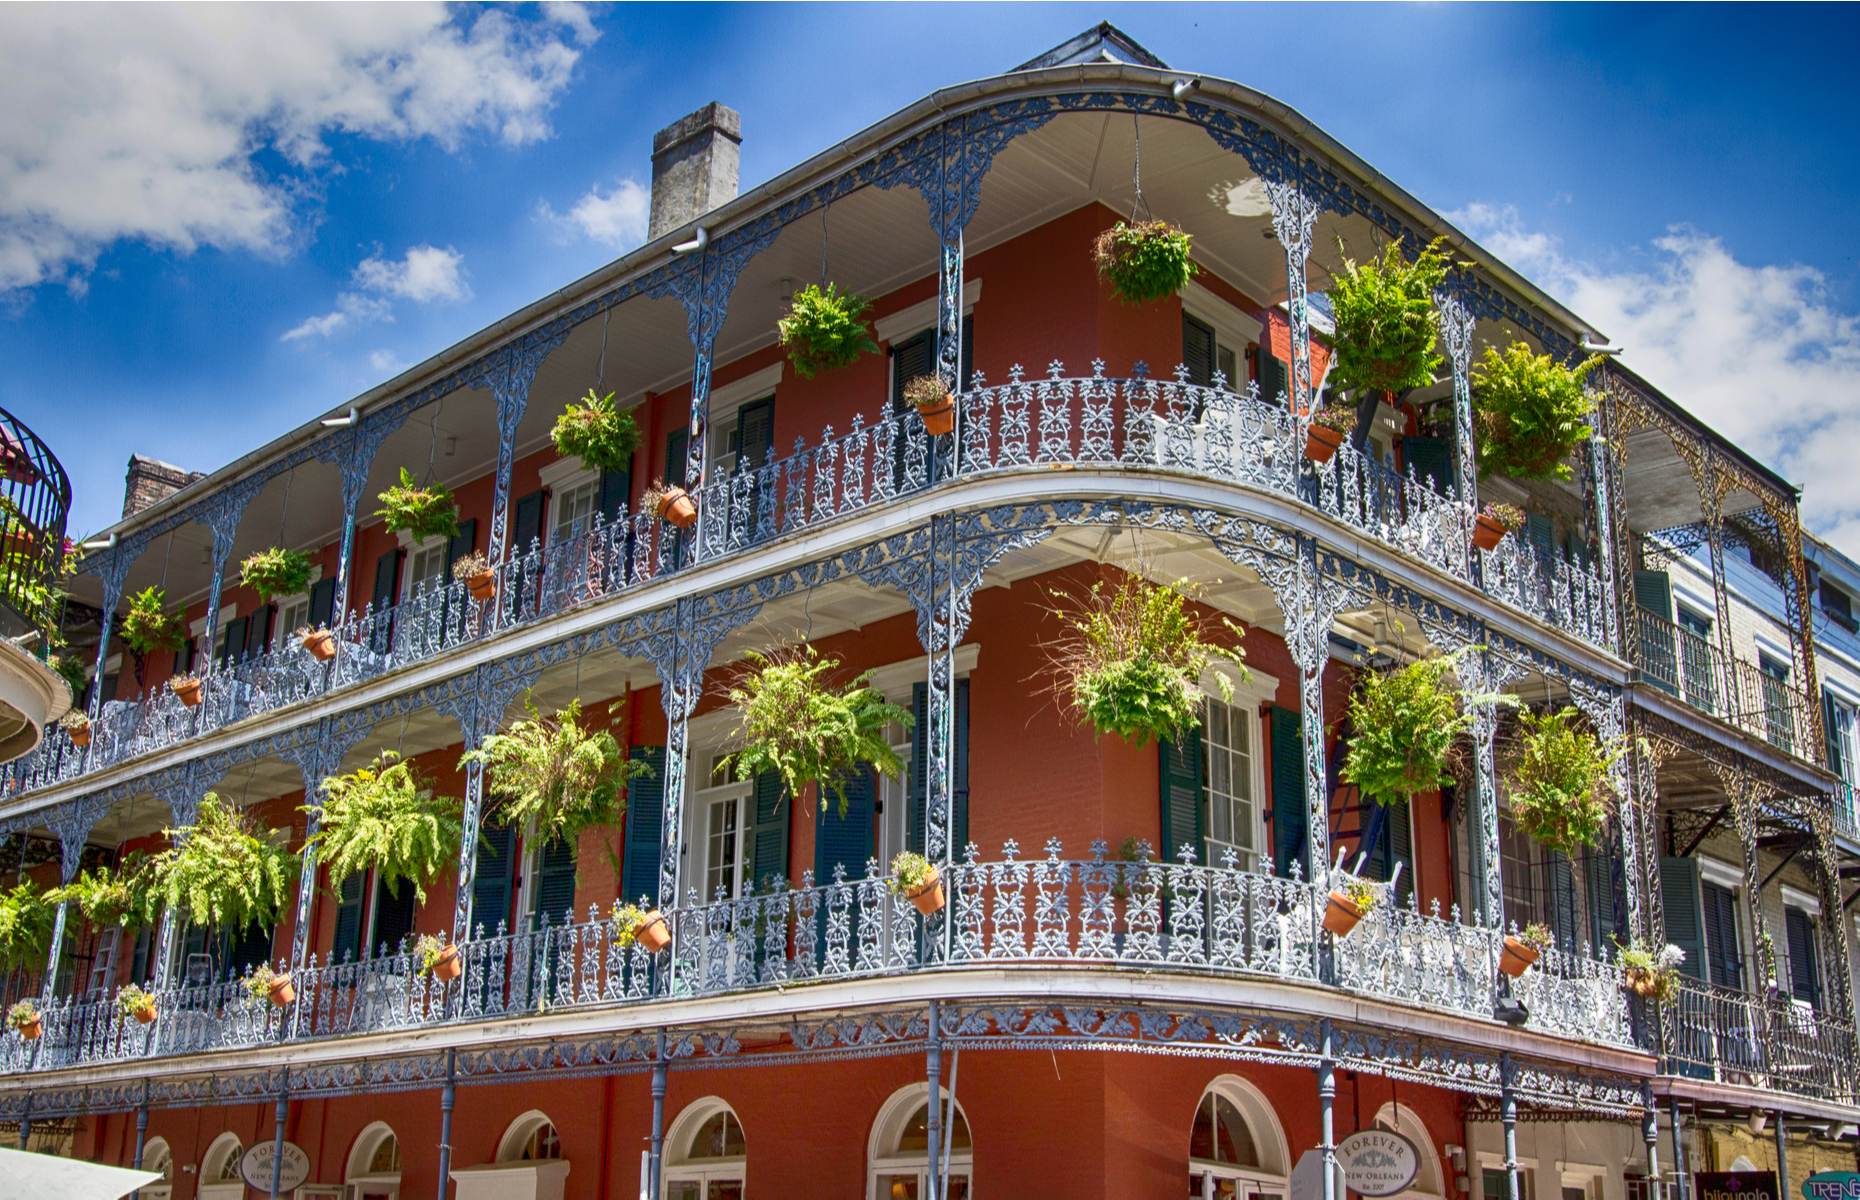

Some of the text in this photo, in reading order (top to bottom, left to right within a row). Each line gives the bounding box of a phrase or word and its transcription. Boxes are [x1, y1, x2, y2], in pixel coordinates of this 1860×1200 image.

[252, 1145, 302, 1164] FORVER
[1344, 1136, 1404, 1158] FOREVER
[1345, 1171, 1404, 1180] NEW ORLEANS
